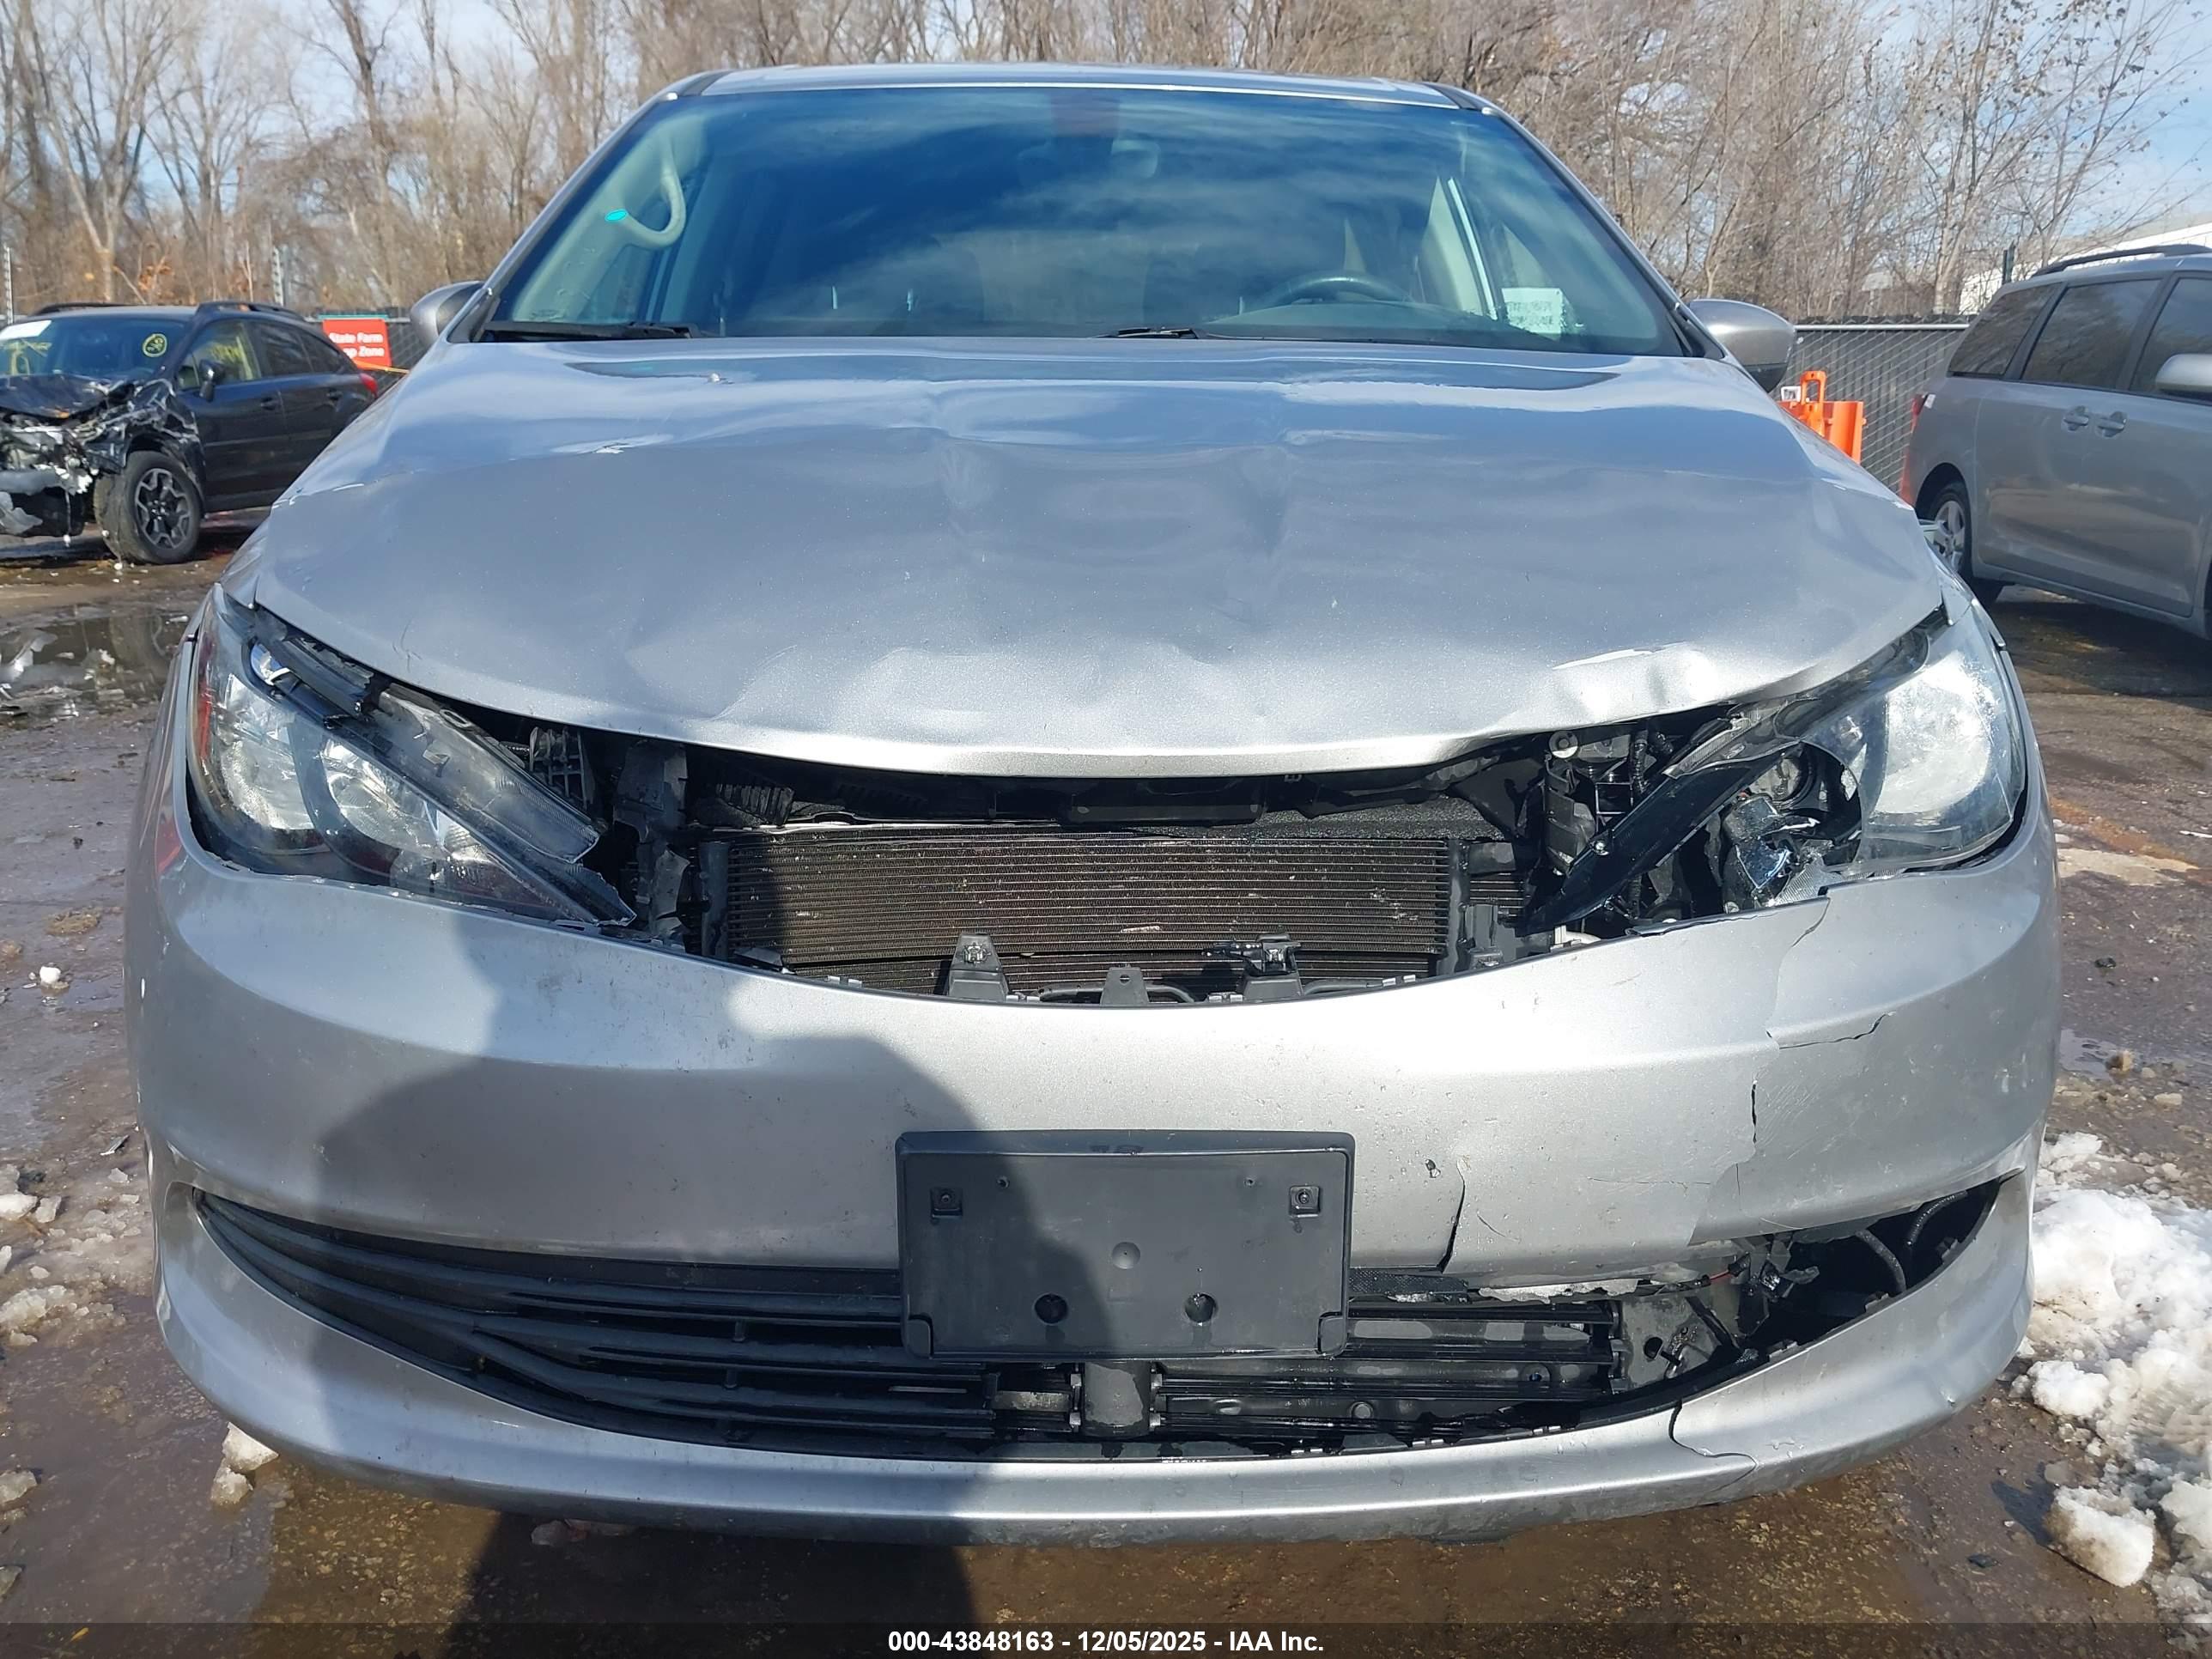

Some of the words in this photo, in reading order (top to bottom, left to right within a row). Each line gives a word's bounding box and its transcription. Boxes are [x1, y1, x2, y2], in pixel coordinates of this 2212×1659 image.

[329, 332, 356, 343] State
[356, 332, 384, 343] Farm
[358, 345, 385, 357] Zone
